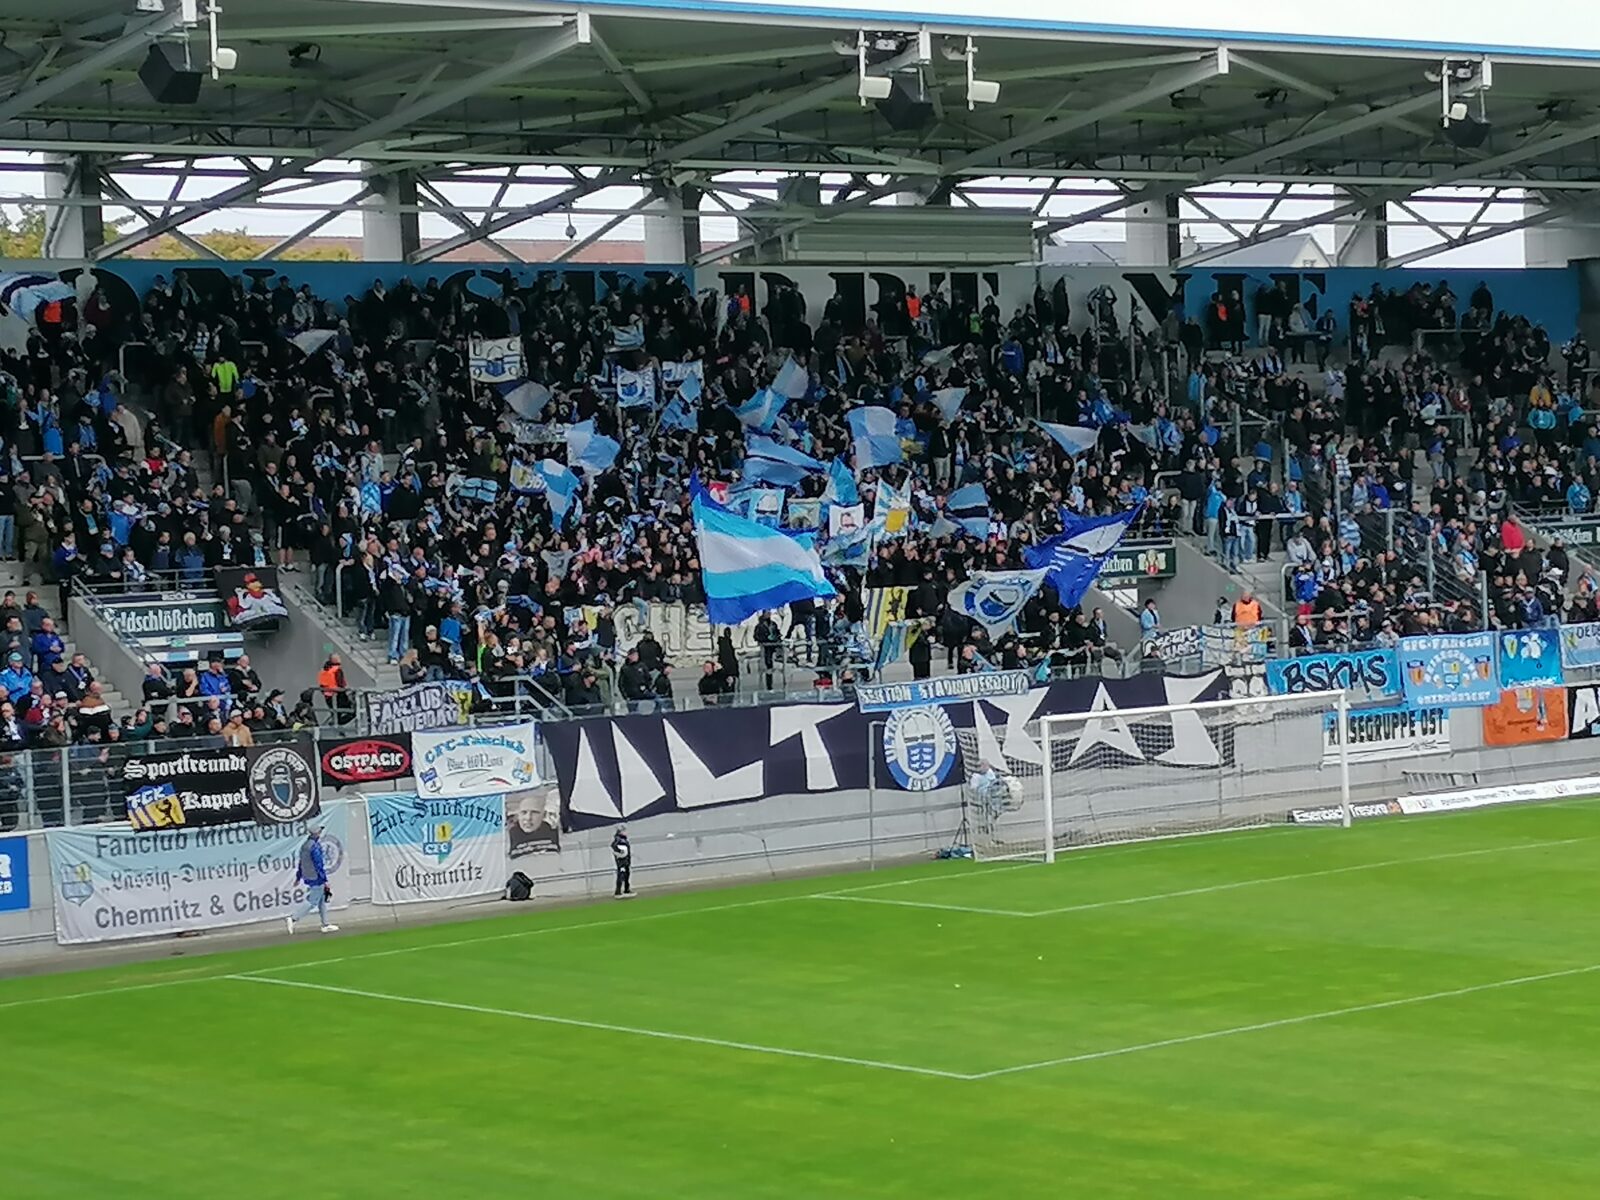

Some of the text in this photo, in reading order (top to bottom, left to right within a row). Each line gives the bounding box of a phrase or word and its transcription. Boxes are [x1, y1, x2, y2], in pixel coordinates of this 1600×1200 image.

[1328, 707, 1444, 746] RISEGRUPPE OST
[95, 830, 188, 858] Fanclub
[95, 886, 305, 929] Chemnitz & Chelse
